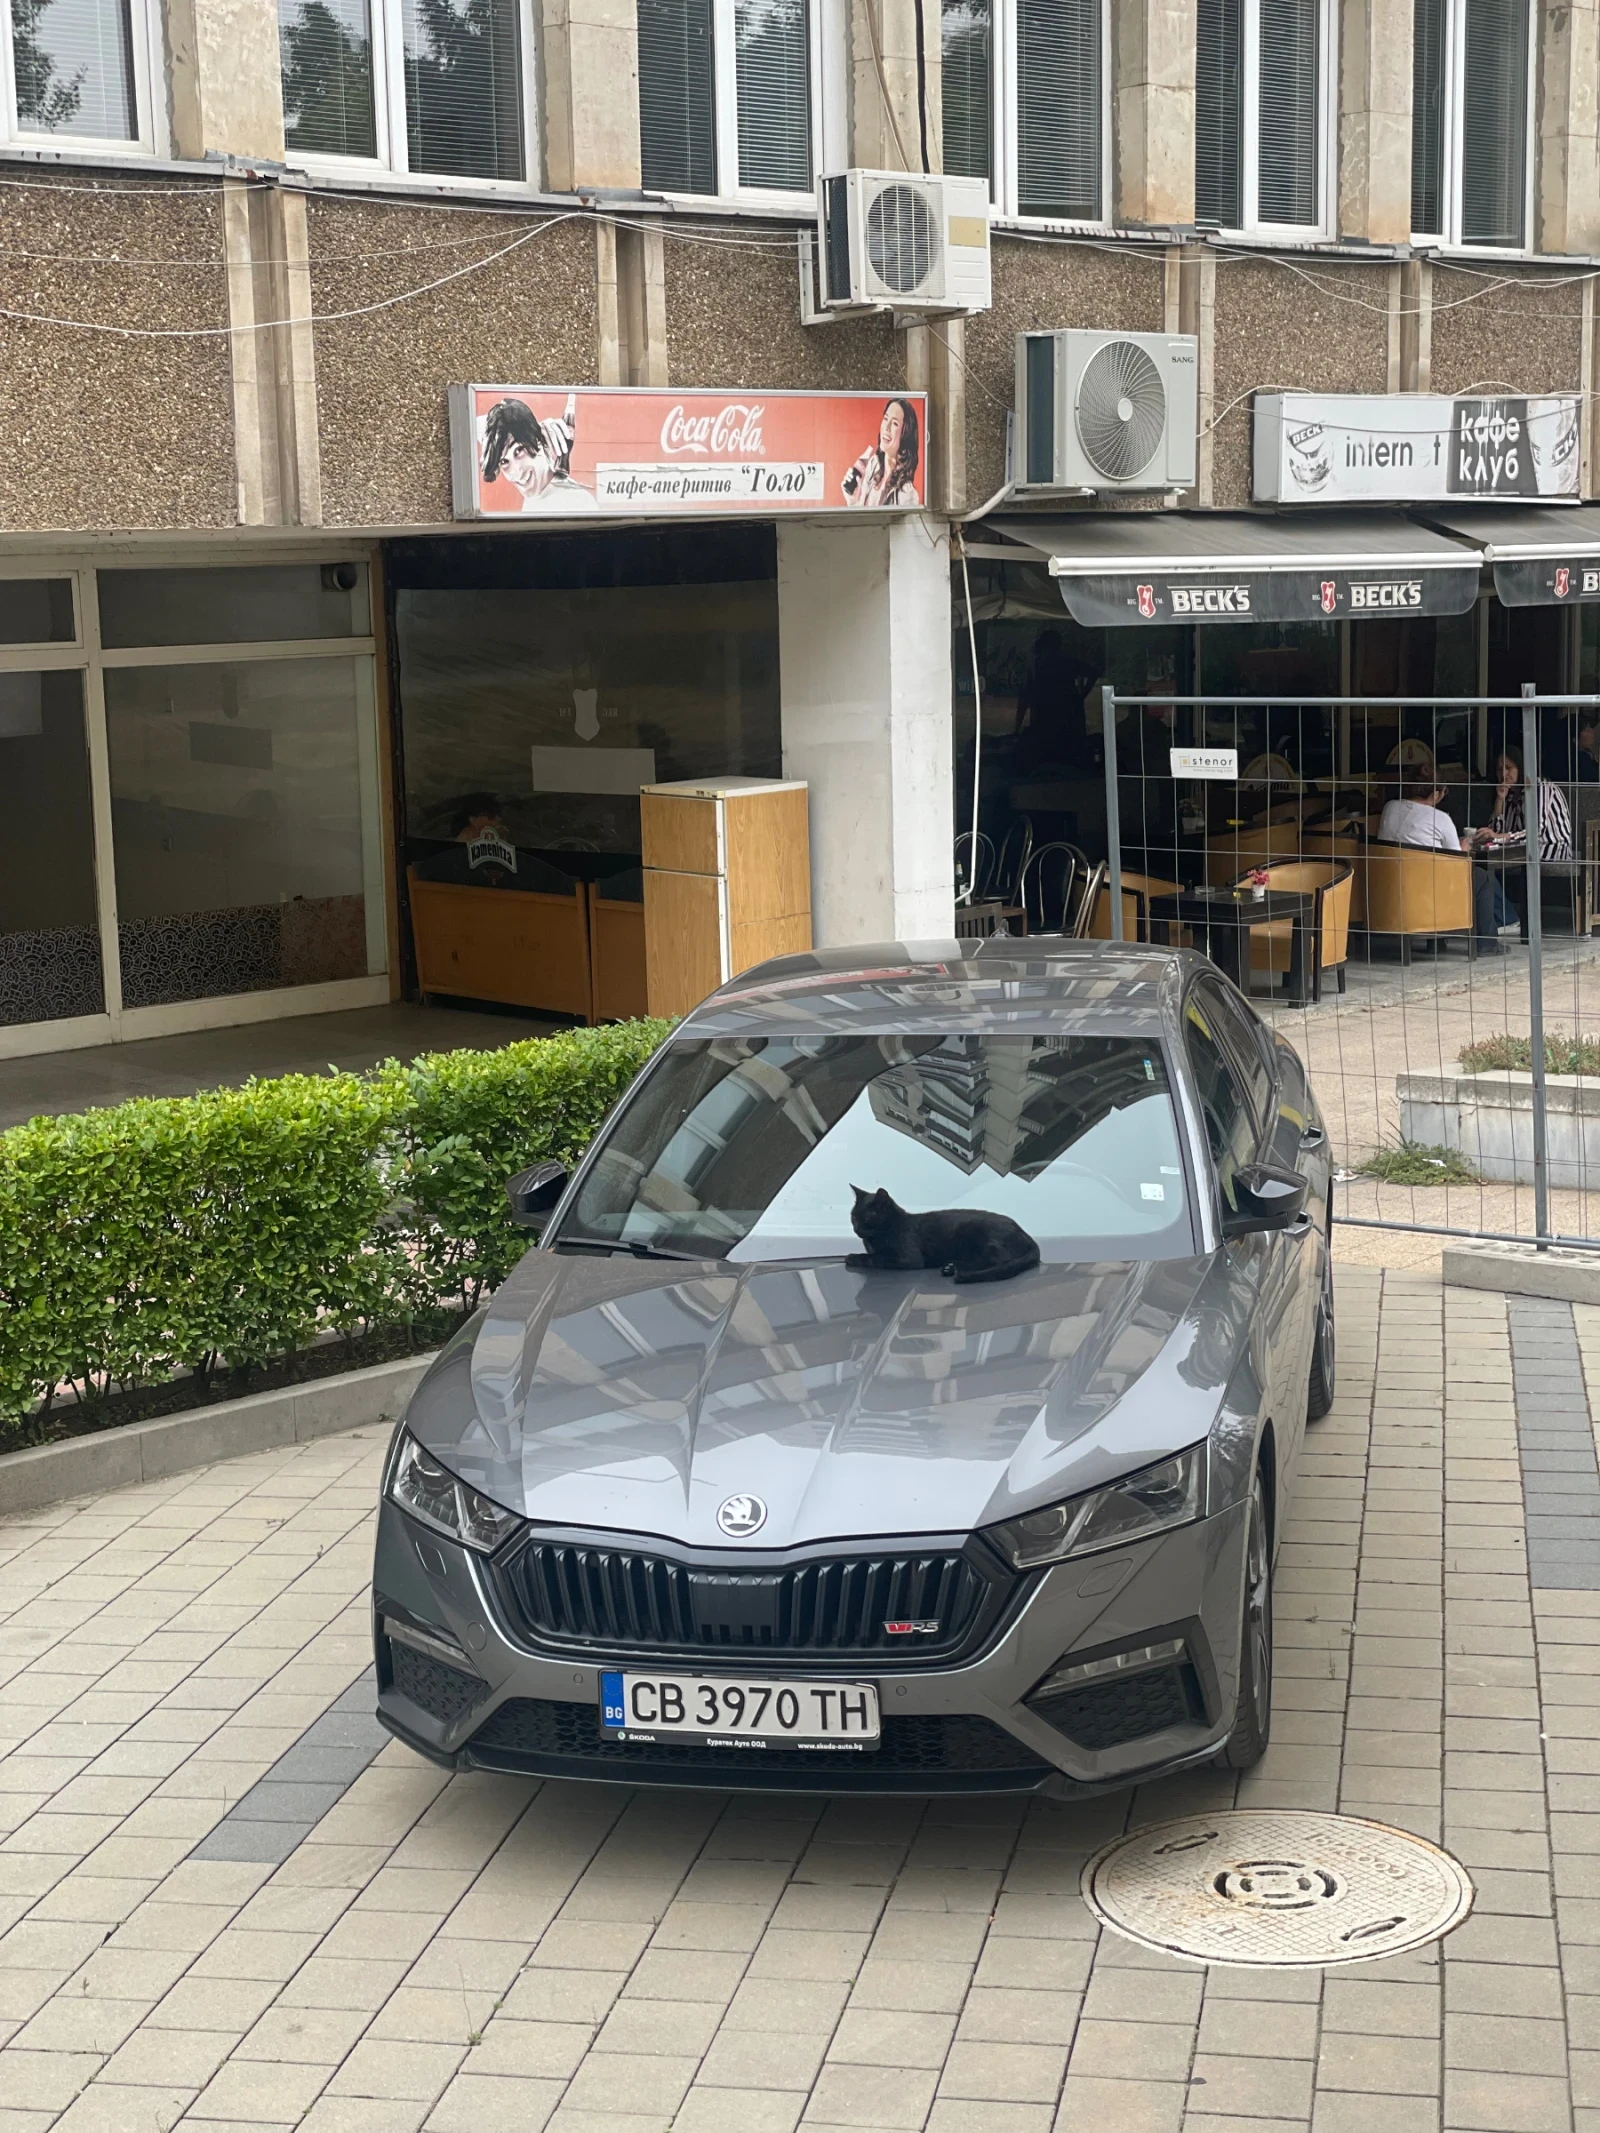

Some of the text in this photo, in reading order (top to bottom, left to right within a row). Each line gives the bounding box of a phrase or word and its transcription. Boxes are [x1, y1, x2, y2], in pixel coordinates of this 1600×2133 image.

[661, 405, 765, 453] Coca-Cola
[606, 476, 732, 499] кафе-аперитив
[1171, 586, 1250, 612] BECK'S
[1351, 581, 1421, 607] BECK'S
[1192, 756, 1233, 766] stenor
[605, 1706, 623, 1719] BG
[631, 1681, 868, 1731] CB 3970 TH
